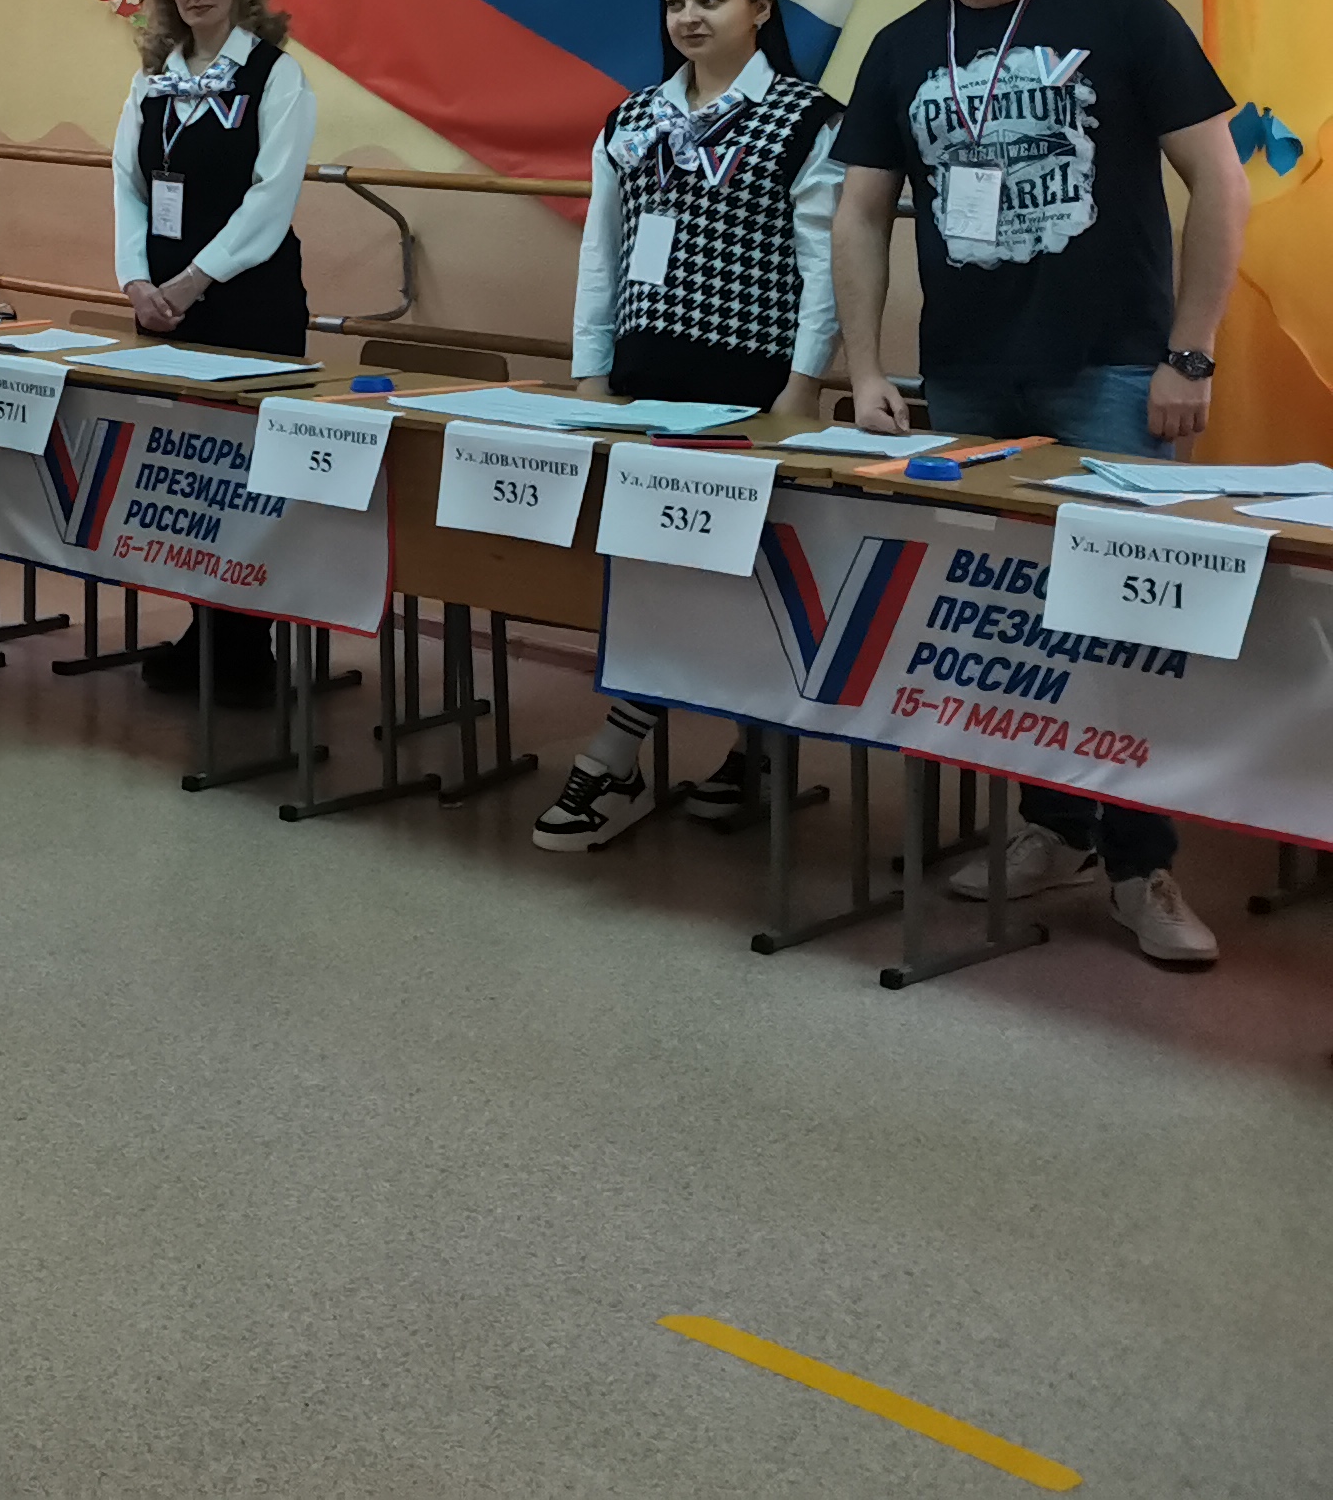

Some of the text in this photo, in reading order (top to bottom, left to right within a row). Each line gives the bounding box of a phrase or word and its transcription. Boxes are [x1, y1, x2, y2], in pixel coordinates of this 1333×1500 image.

[922, 84, 1079, 145] PREMIUM
[1008, 141, 1049, 158] WEAR
[288, 422, 378, 446] ДОВАТОРЦЕВ
[309, 450, 332, 473] 55
[479, 451, 579, 478] ДОВАТОРЦЕВ
[135, 462, 286, 519] ПРЕЗИДЕНТА
[492, 479, 539, 507] 53/3
[646, 475, 759, 502] ДОВАТОРЦЕВ
[123, 499, 222, 543] РОССИИ
[660, 505, 712, 534] 53/2
[163, 543, 222, 579] МАРТА
[220, 559, 268, 587] 2024
[1103, 540, 1246, 574] ДОВАТОРЦЕВ
[1121, 575, 1183, 609] 53/1
[906, 642, 1071, 705] РОССИИ
[963, 703, 1070, 751] МАРТА
[1073, 727, 1150, 769] 2024
